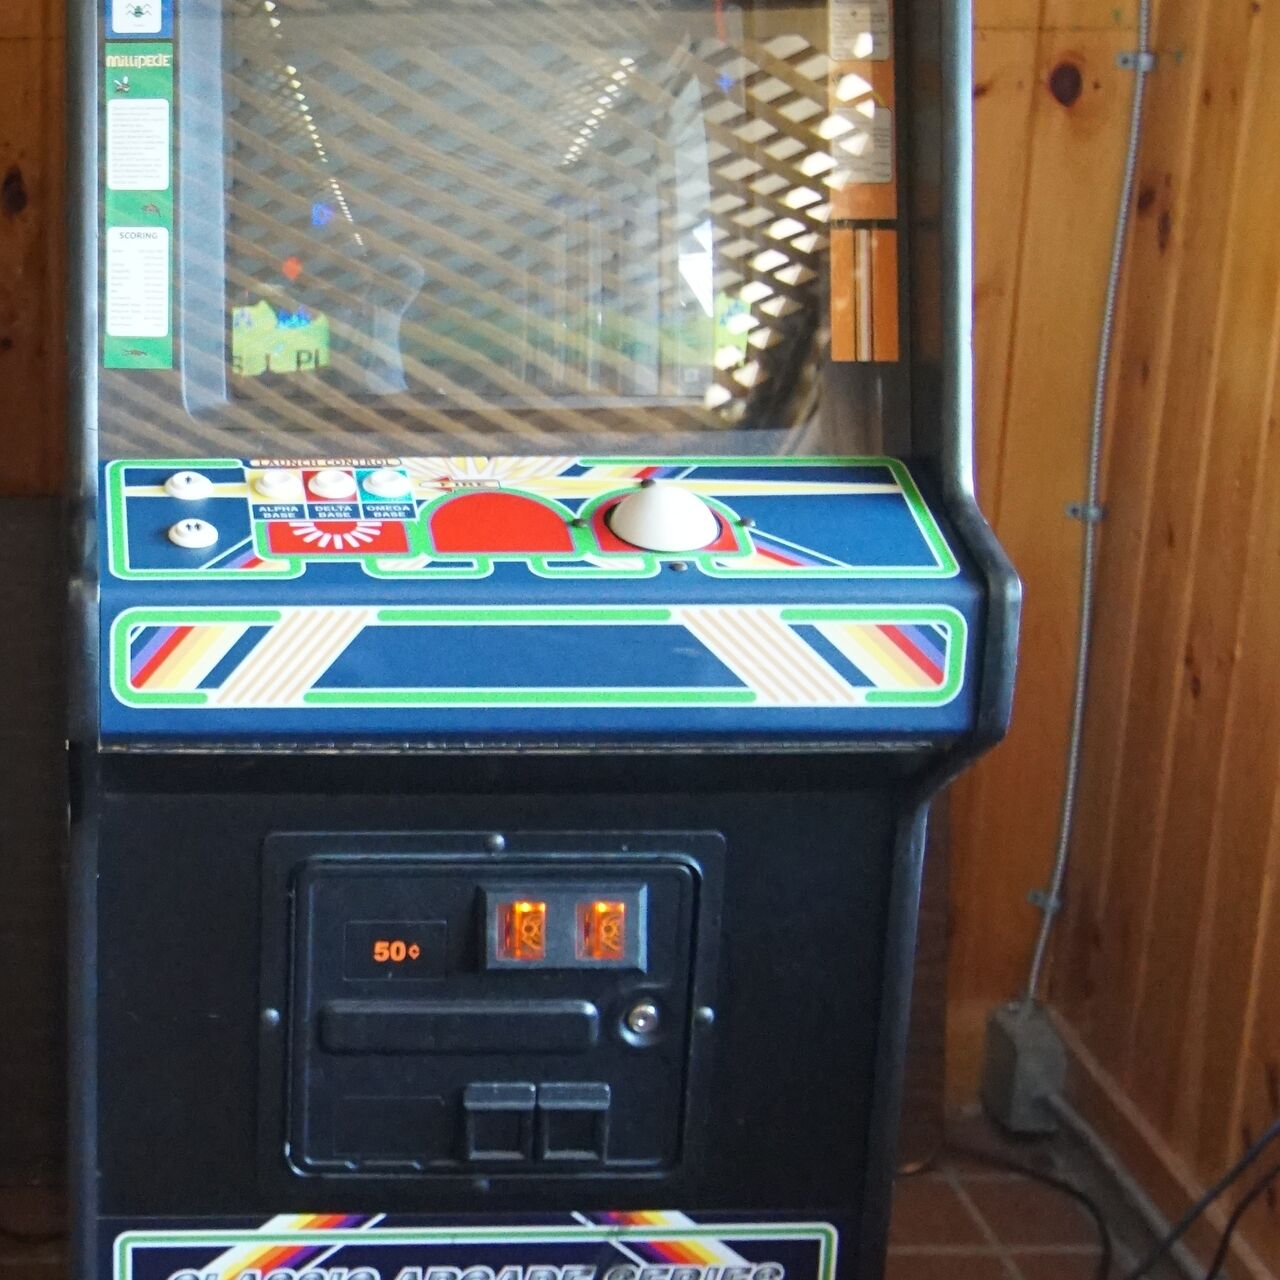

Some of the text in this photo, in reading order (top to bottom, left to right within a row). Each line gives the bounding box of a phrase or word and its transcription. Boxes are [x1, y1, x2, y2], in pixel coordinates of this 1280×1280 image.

[119, 231, 159, 240] SCORING
[257, 458, 399, 468] LAUNCH CONTROL
[258, 504, 410, 513] ALPHA DELTA OMEGA
[263, 510, 406, 519] BASE BASE BASE
[373, 939, 421, 963] 50¢
